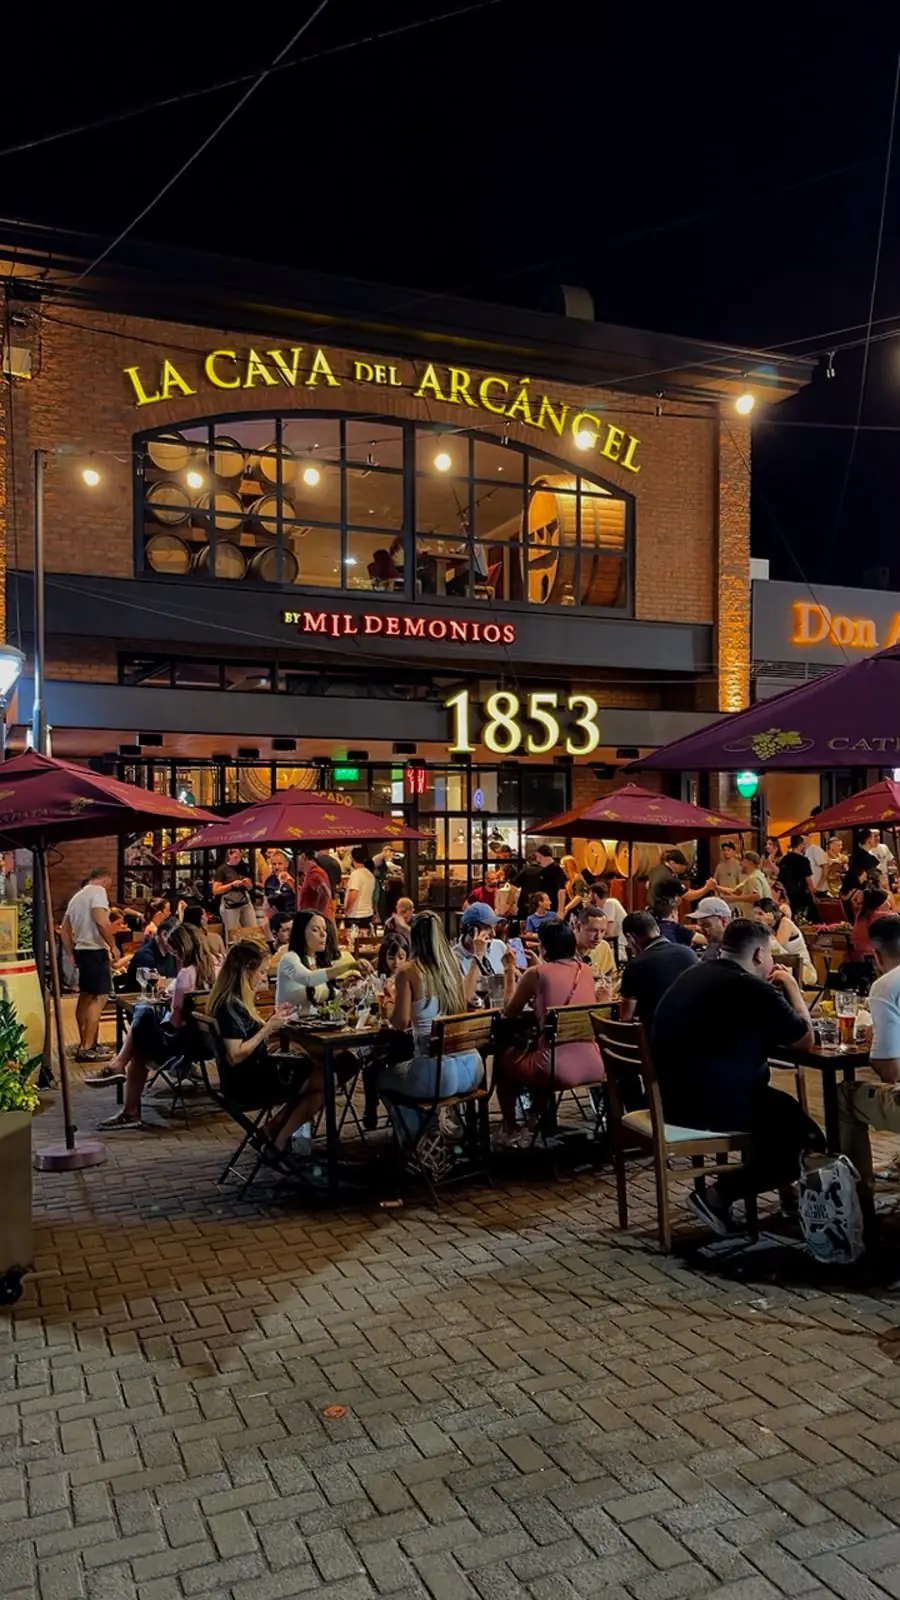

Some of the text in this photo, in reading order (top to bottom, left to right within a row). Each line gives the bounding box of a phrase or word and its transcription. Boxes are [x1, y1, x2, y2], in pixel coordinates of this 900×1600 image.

[125, 346, 642, 474] LA CAVA DEL ARCÁNGEL
[283, 612, 516, 643] BY MIL DEMONIOS
[791, 600, 880, 649] Don
[443, 688, 601, 755] 1853
